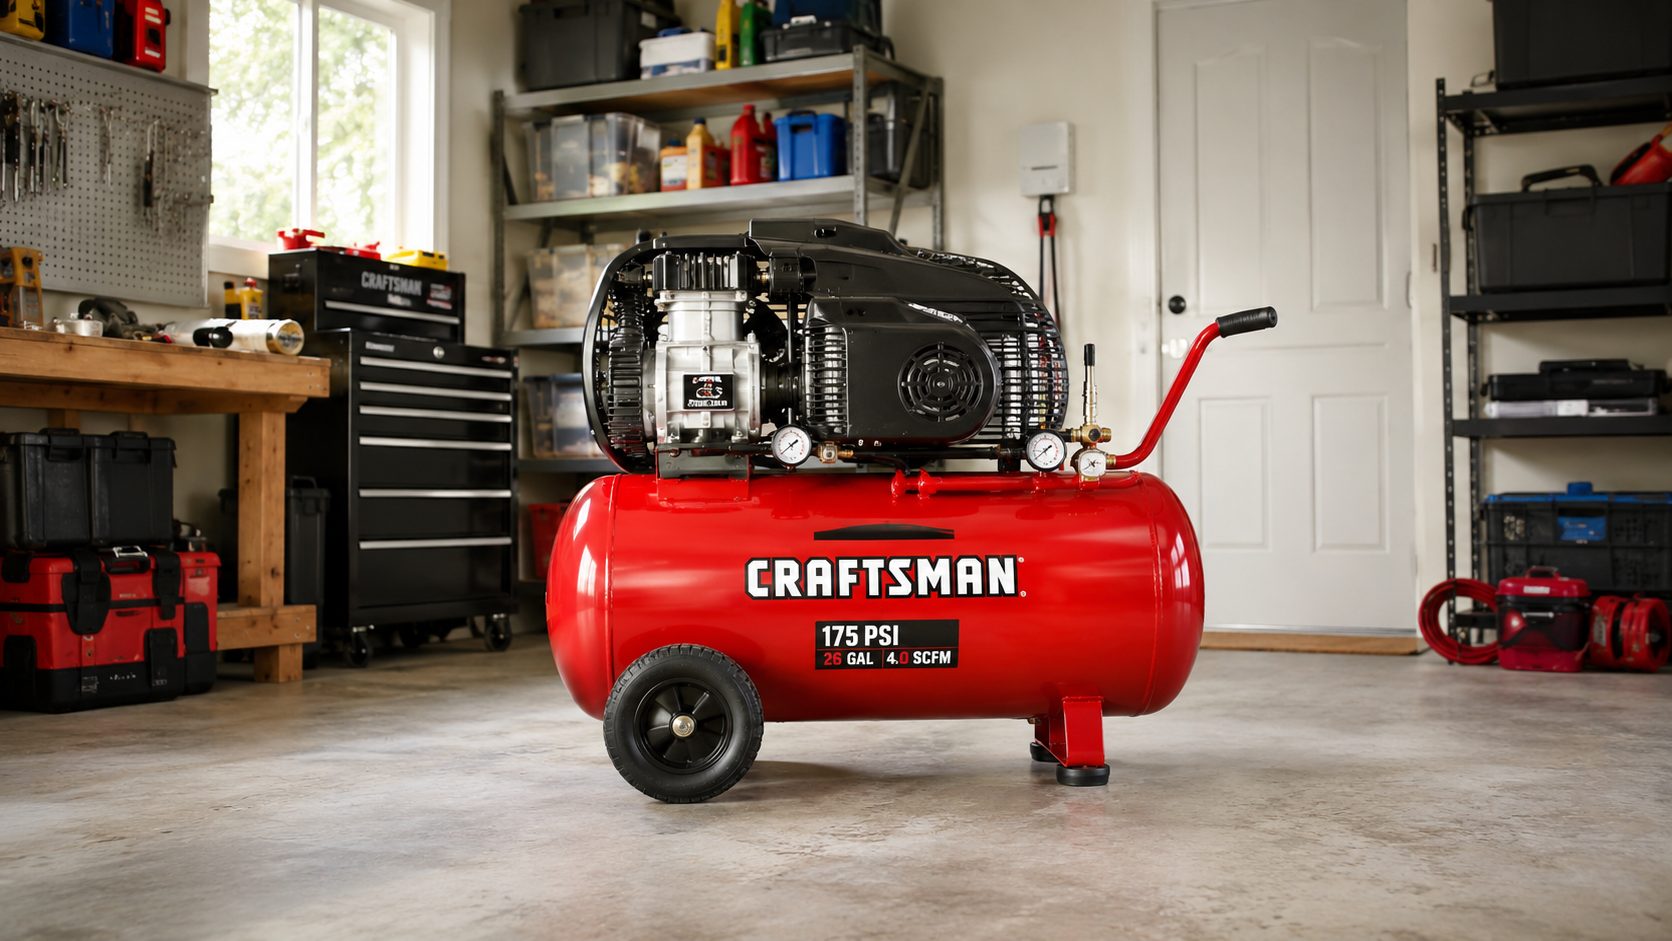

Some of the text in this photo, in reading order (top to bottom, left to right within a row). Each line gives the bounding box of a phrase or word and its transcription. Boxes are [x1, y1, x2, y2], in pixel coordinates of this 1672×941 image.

[361, 271, 422, 295] CRAFTSMAN
[745, 555, 1018, 599] CRAFTSMAN
[822, 624, 899, 647] 175 PSI
[823, 650, 951, 666] 26 GAL 4.0 SCFM
